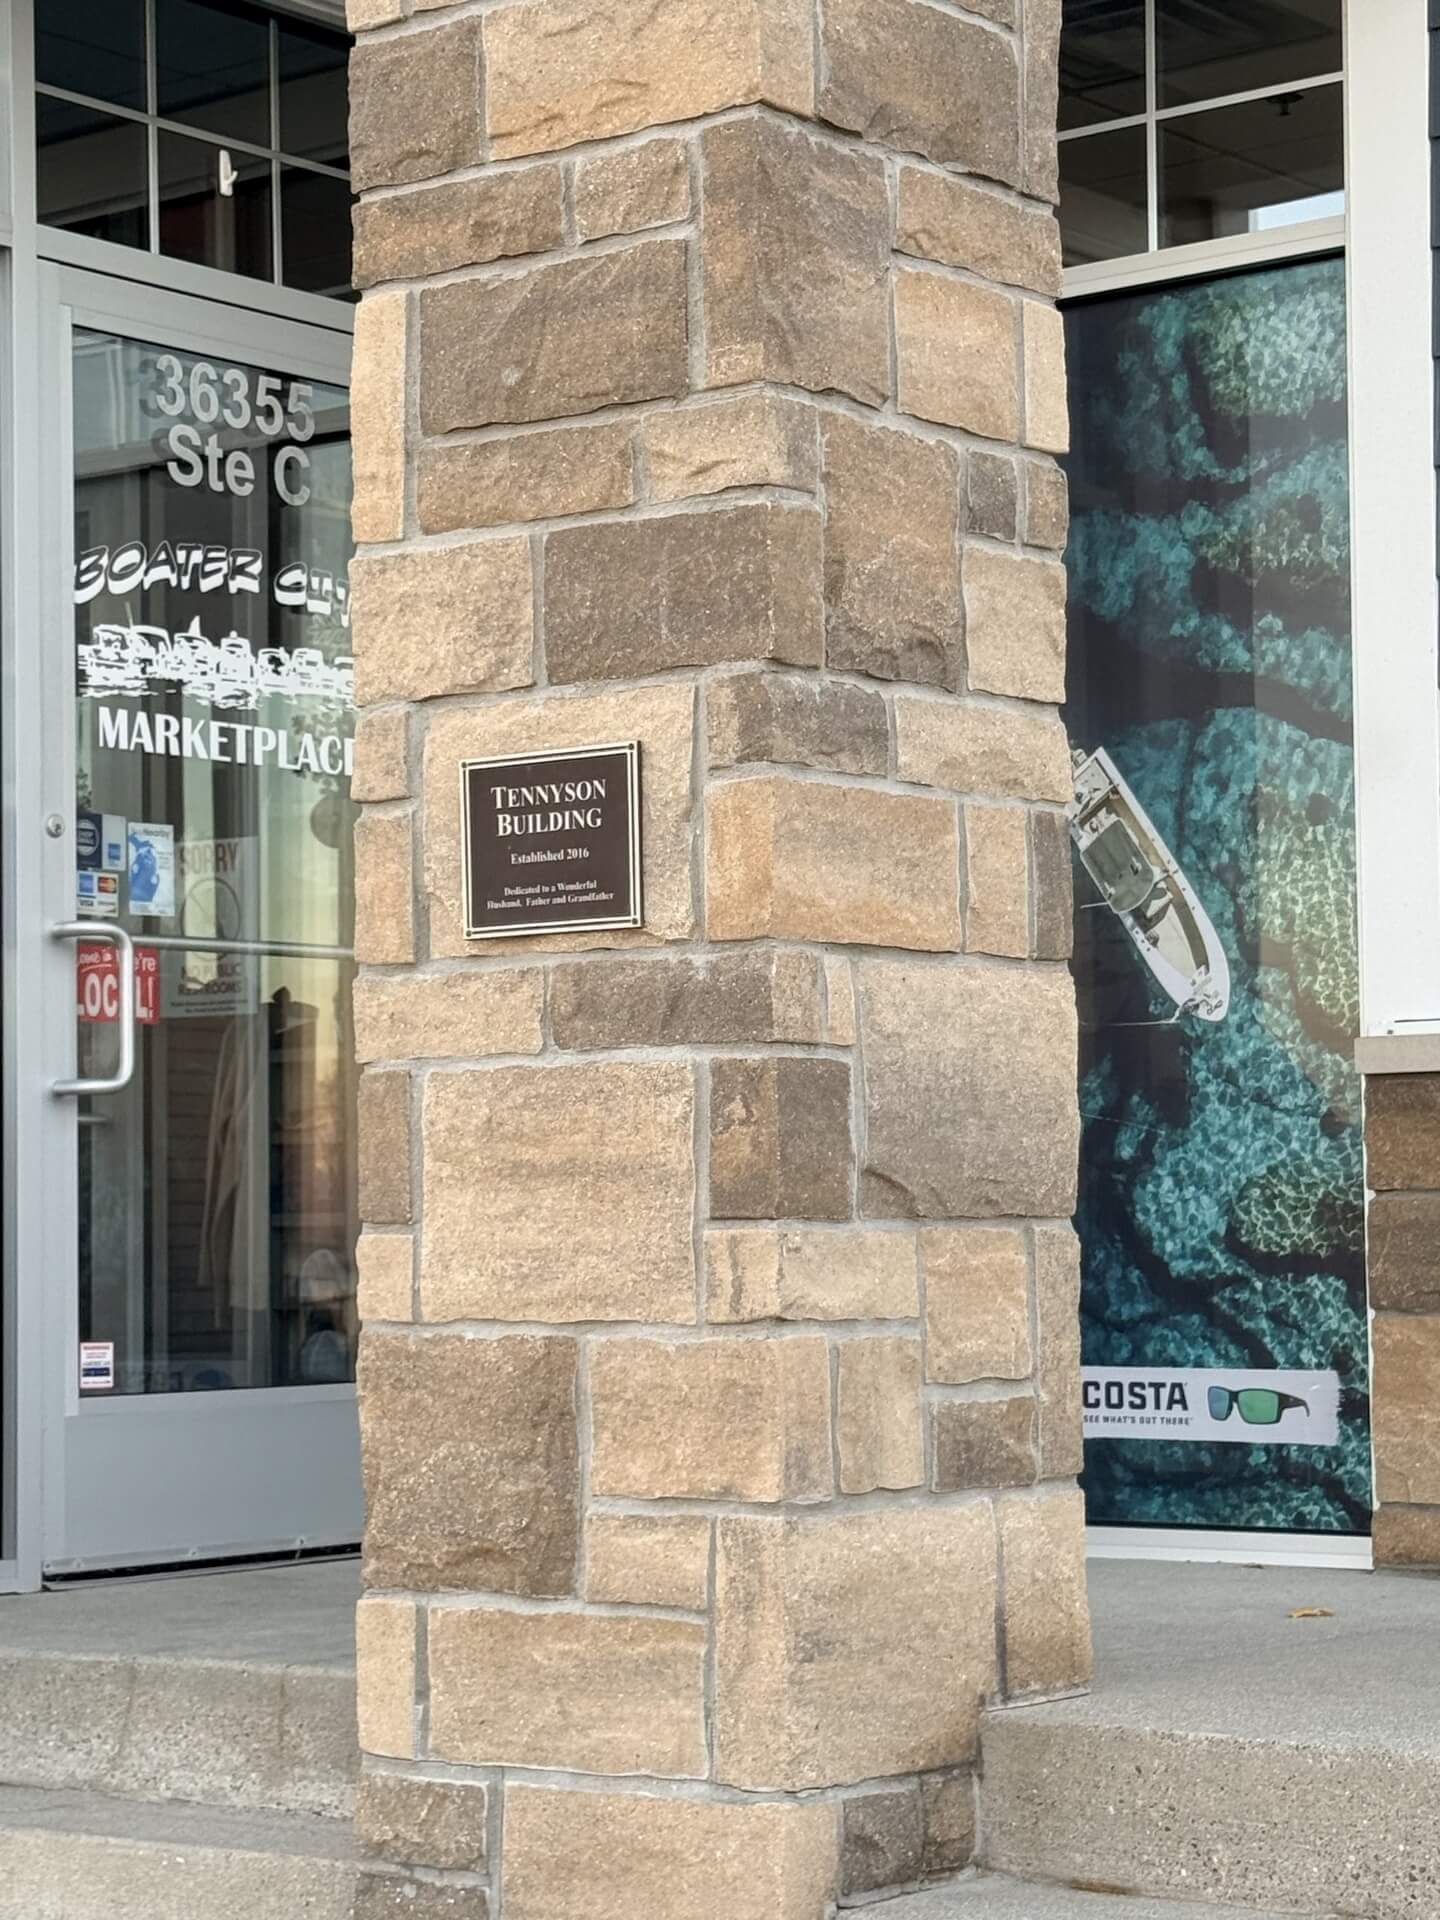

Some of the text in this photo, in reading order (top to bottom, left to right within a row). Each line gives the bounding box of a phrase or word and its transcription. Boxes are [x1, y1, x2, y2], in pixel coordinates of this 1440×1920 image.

[156, 354, 315, 442] 36355
[167, 424, 311, 506] Ste C
[75, 540, 262, 604] BOATER
[490, 779, 606, 809] TENNYSON
[497, 807, 602, 836] BUILDING
[180, 843, 239, 879] SORRY
[511, 847, 590, 864] Established 2016
[504, 884, 541, 896] Dedicated
[542, 884, 550, 893] to
[557, 880, 597, 891] Wonderful
[526, 896, 550, 907] Father
[552, 895, 566, 904] and
[78, 973, 154, 1017] OCL!
[1082, 1381, 1188, 1411] COSTA
[1083, 1414, 1099, 1423] SEE
[1103, 1415, 1136, 1424] WHAT'S
[1160, 1416, 1190, 1426] THERE
